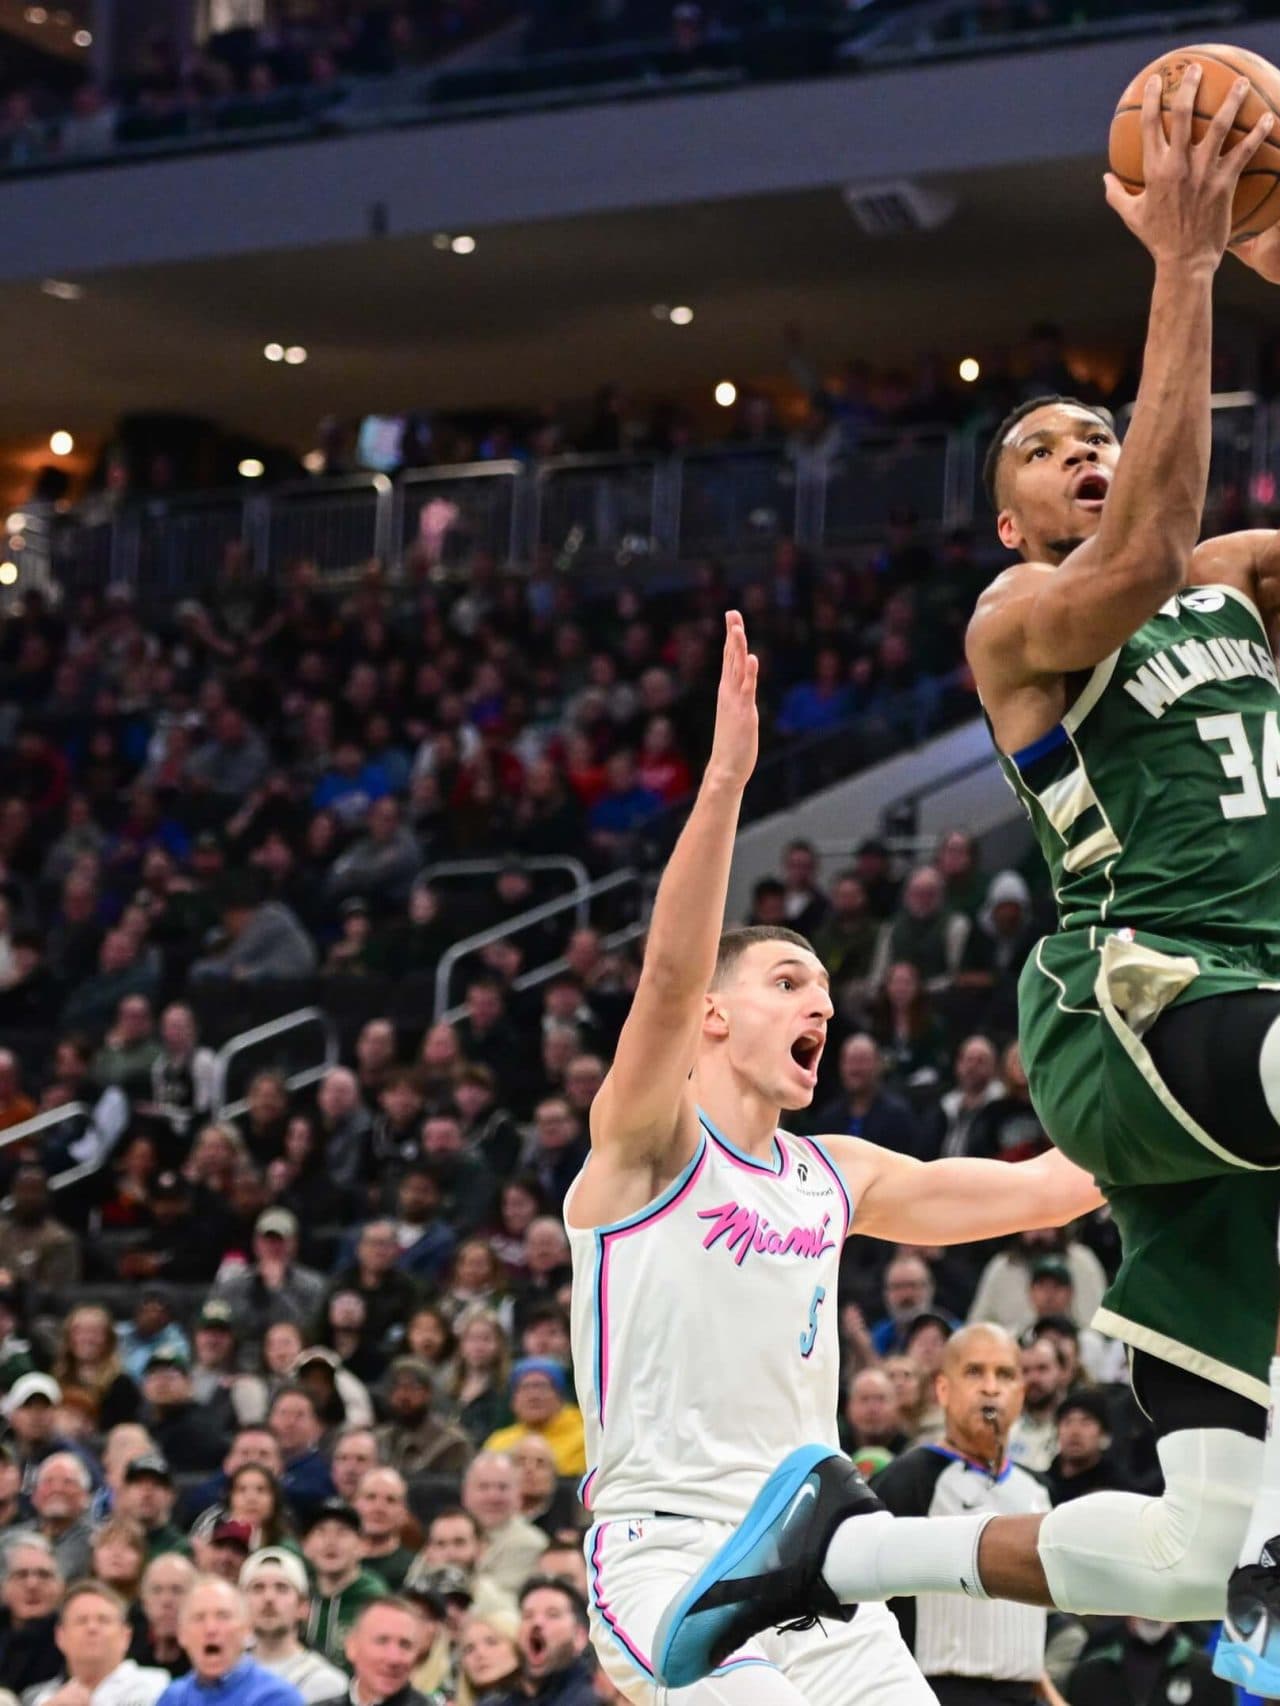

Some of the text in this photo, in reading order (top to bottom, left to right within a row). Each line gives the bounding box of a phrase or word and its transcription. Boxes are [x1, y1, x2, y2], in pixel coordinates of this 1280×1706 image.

[1122, 636, 1280, 720] MILWUKE
[696, 1201, 836, 1267] Miami
[799, 1285, 826, 1360] 5
